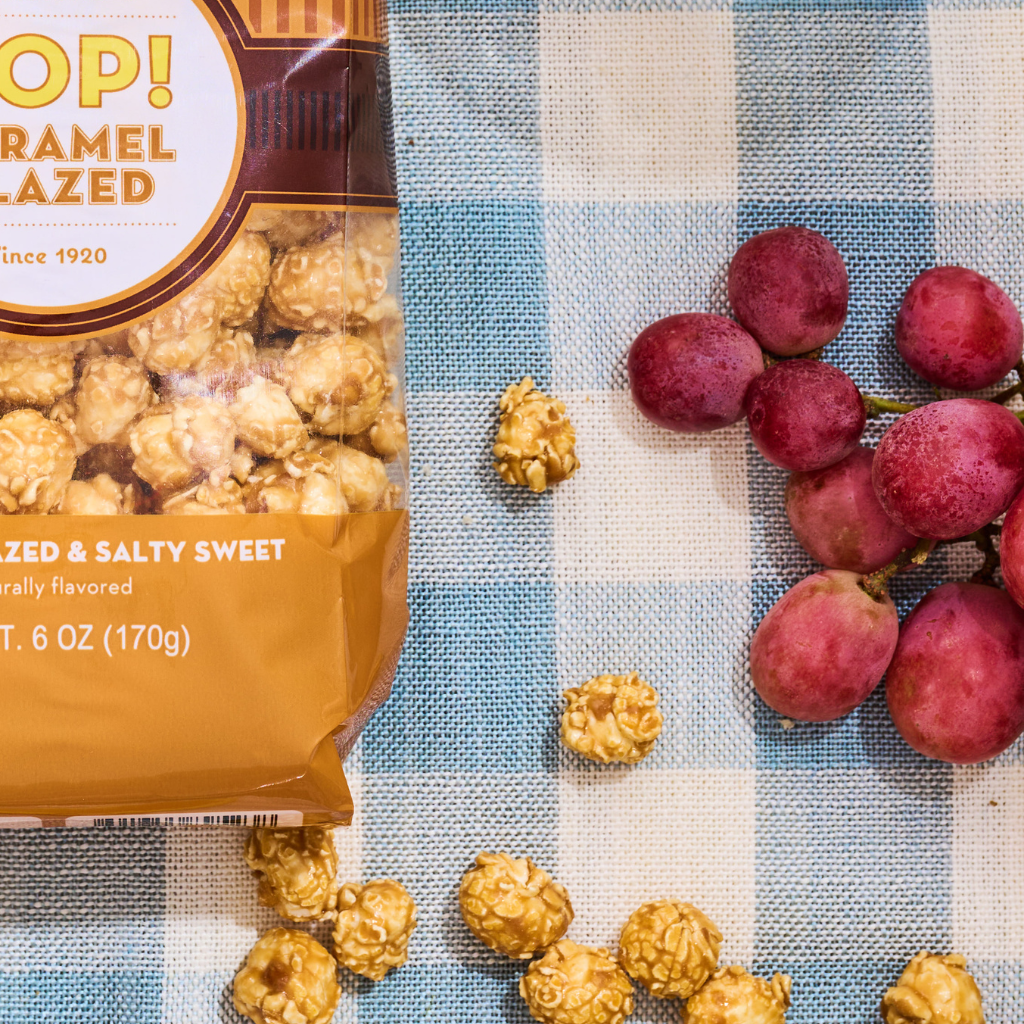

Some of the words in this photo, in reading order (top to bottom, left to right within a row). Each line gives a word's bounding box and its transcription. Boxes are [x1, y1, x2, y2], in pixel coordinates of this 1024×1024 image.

[55, 248, 108, 264] 1920
[67, 541, 87, 563] &
[95, 540, 187, 563] SALTY
[194, 538, 286, 562] SWEET
[51, 576, 133, 596] flavored
[31, 624, 48, 651] 6
[57, 624, 94, 651] OZ
[103, 624, 191, 657] (170g)
